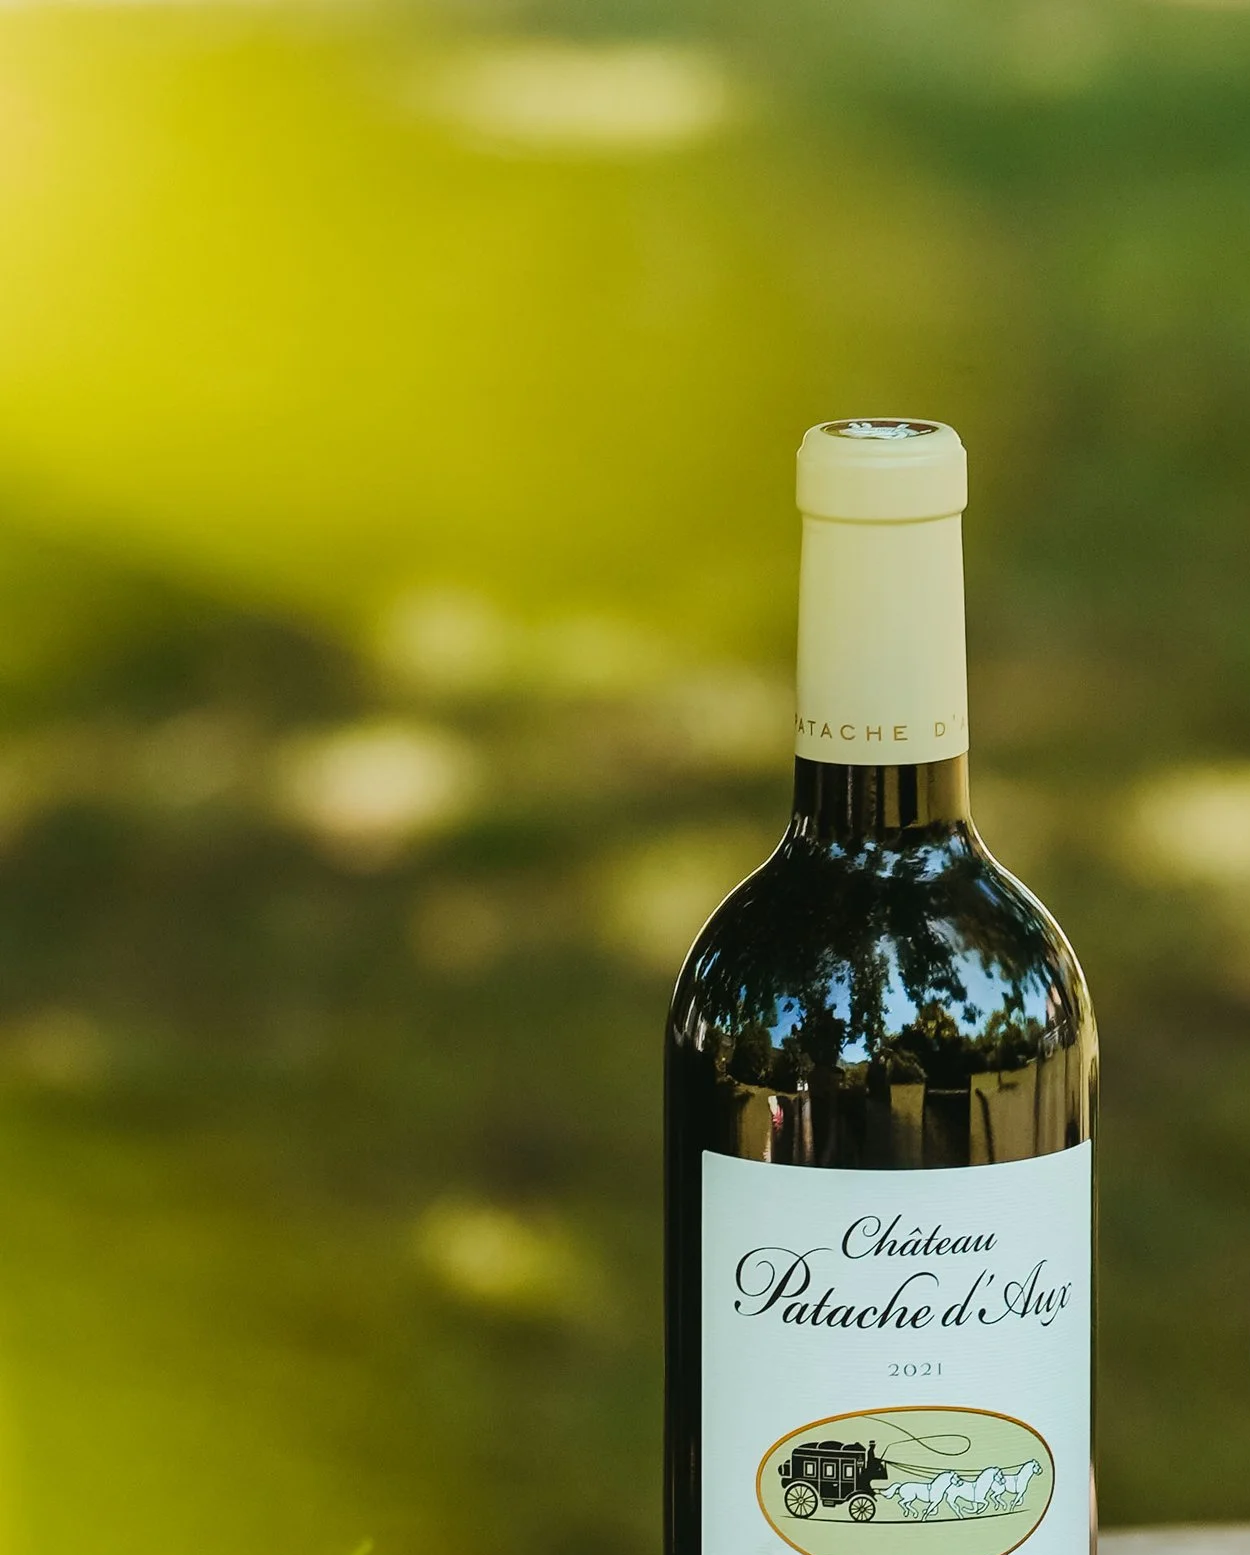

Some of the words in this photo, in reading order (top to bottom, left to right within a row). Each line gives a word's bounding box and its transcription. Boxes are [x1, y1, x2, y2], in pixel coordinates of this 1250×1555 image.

[841, 1214, 998, 1260] Château
[734, 1247, 940, 1329] Patache
[942, 1259, 1072, 1328] d'Aux
[888, 1362, 943, 1378] 2021
